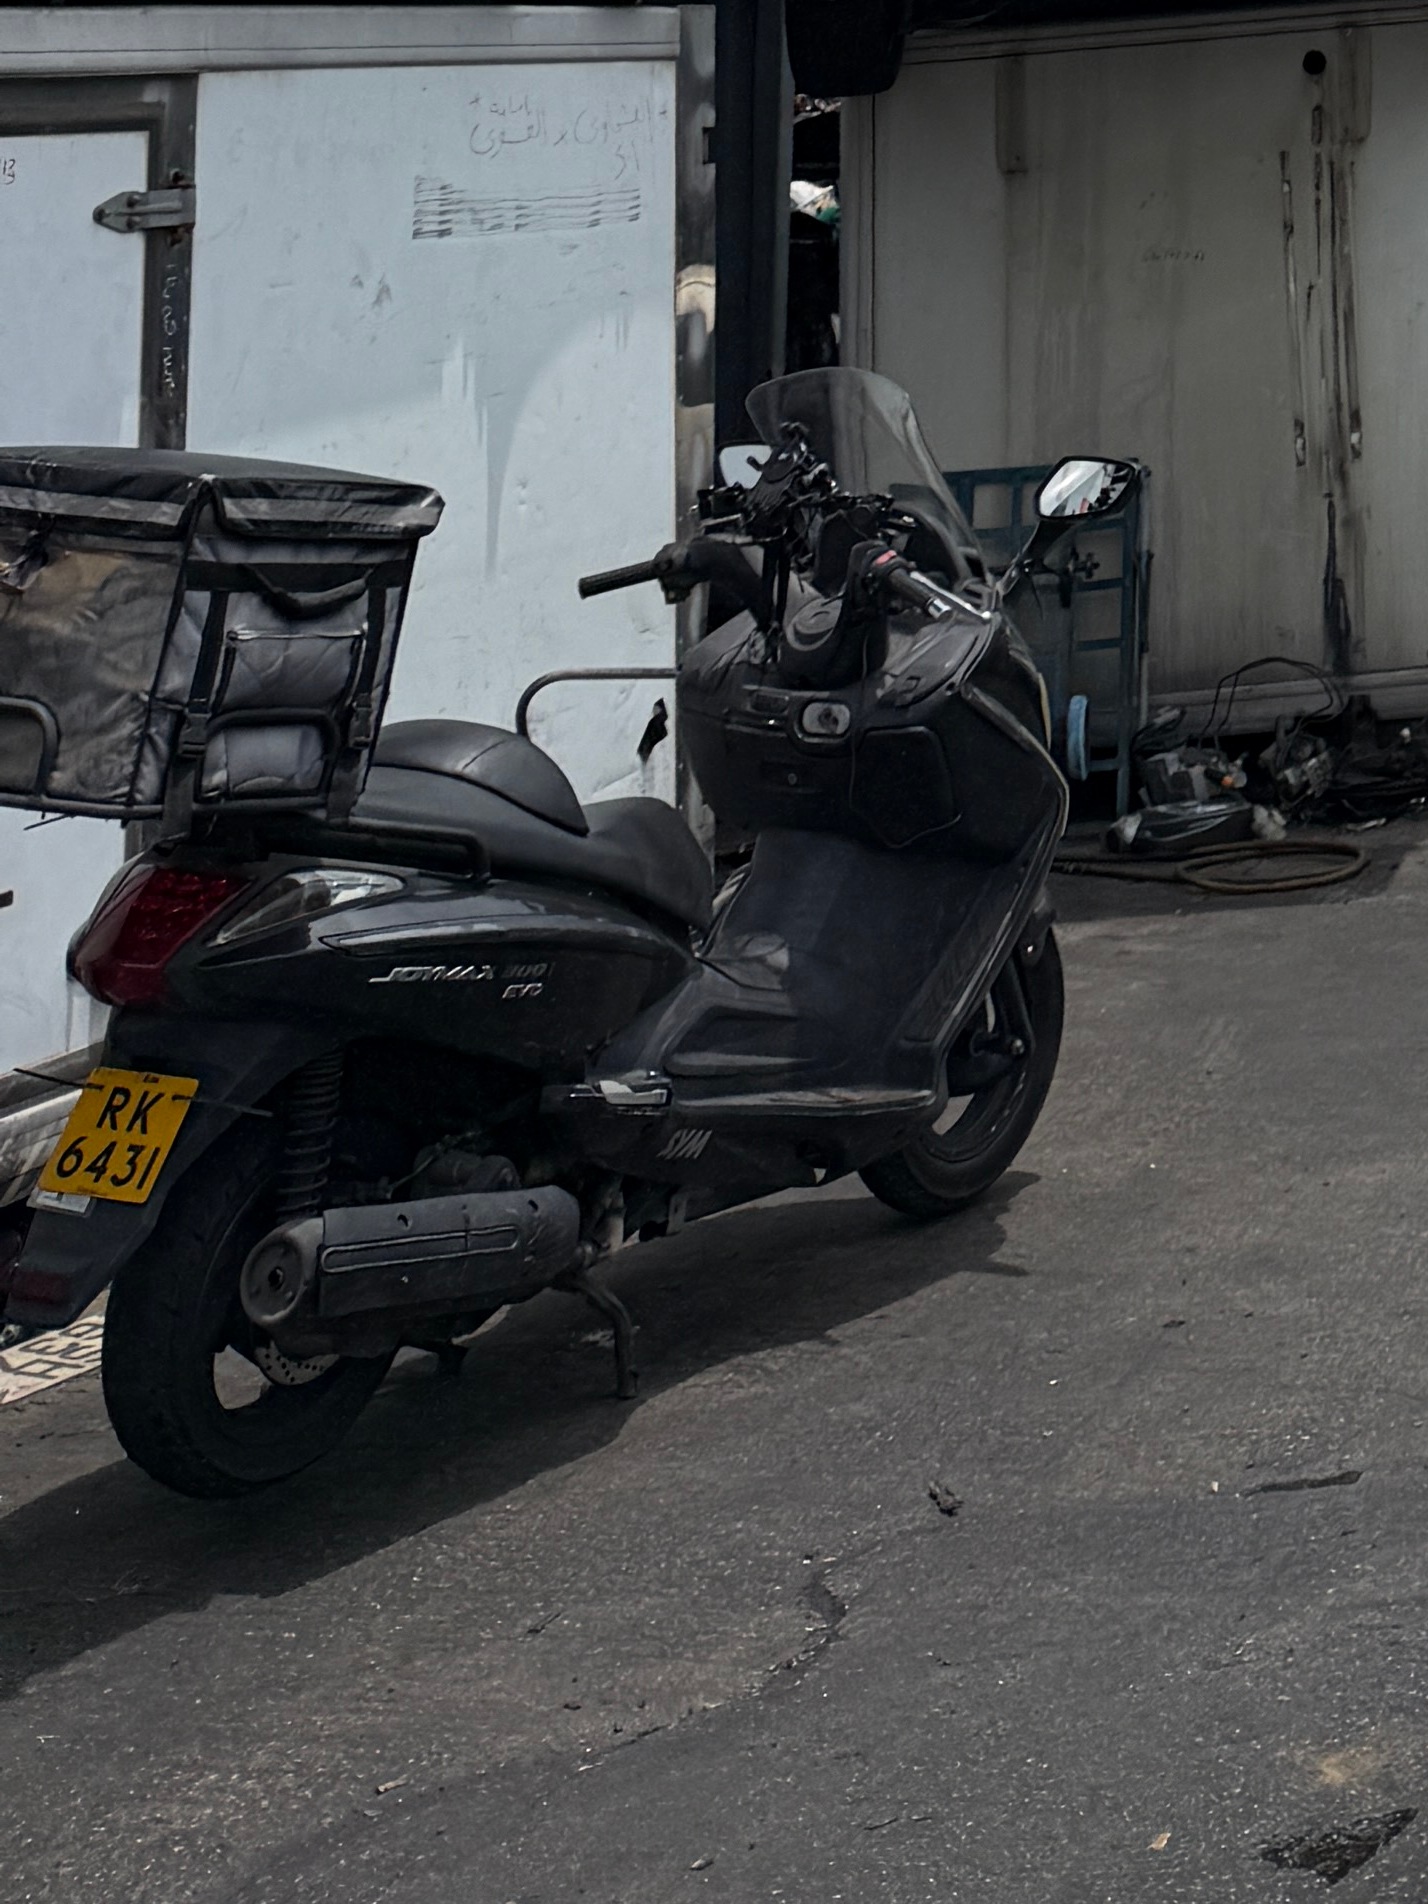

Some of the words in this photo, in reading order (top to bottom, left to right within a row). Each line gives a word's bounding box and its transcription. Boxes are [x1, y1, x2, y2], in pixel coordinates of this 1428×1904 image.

[96, 1087, 165, 1135] RK
[56, 1136, 161, 1190] 6431
[656, 1129, 713, 1160] SYM
